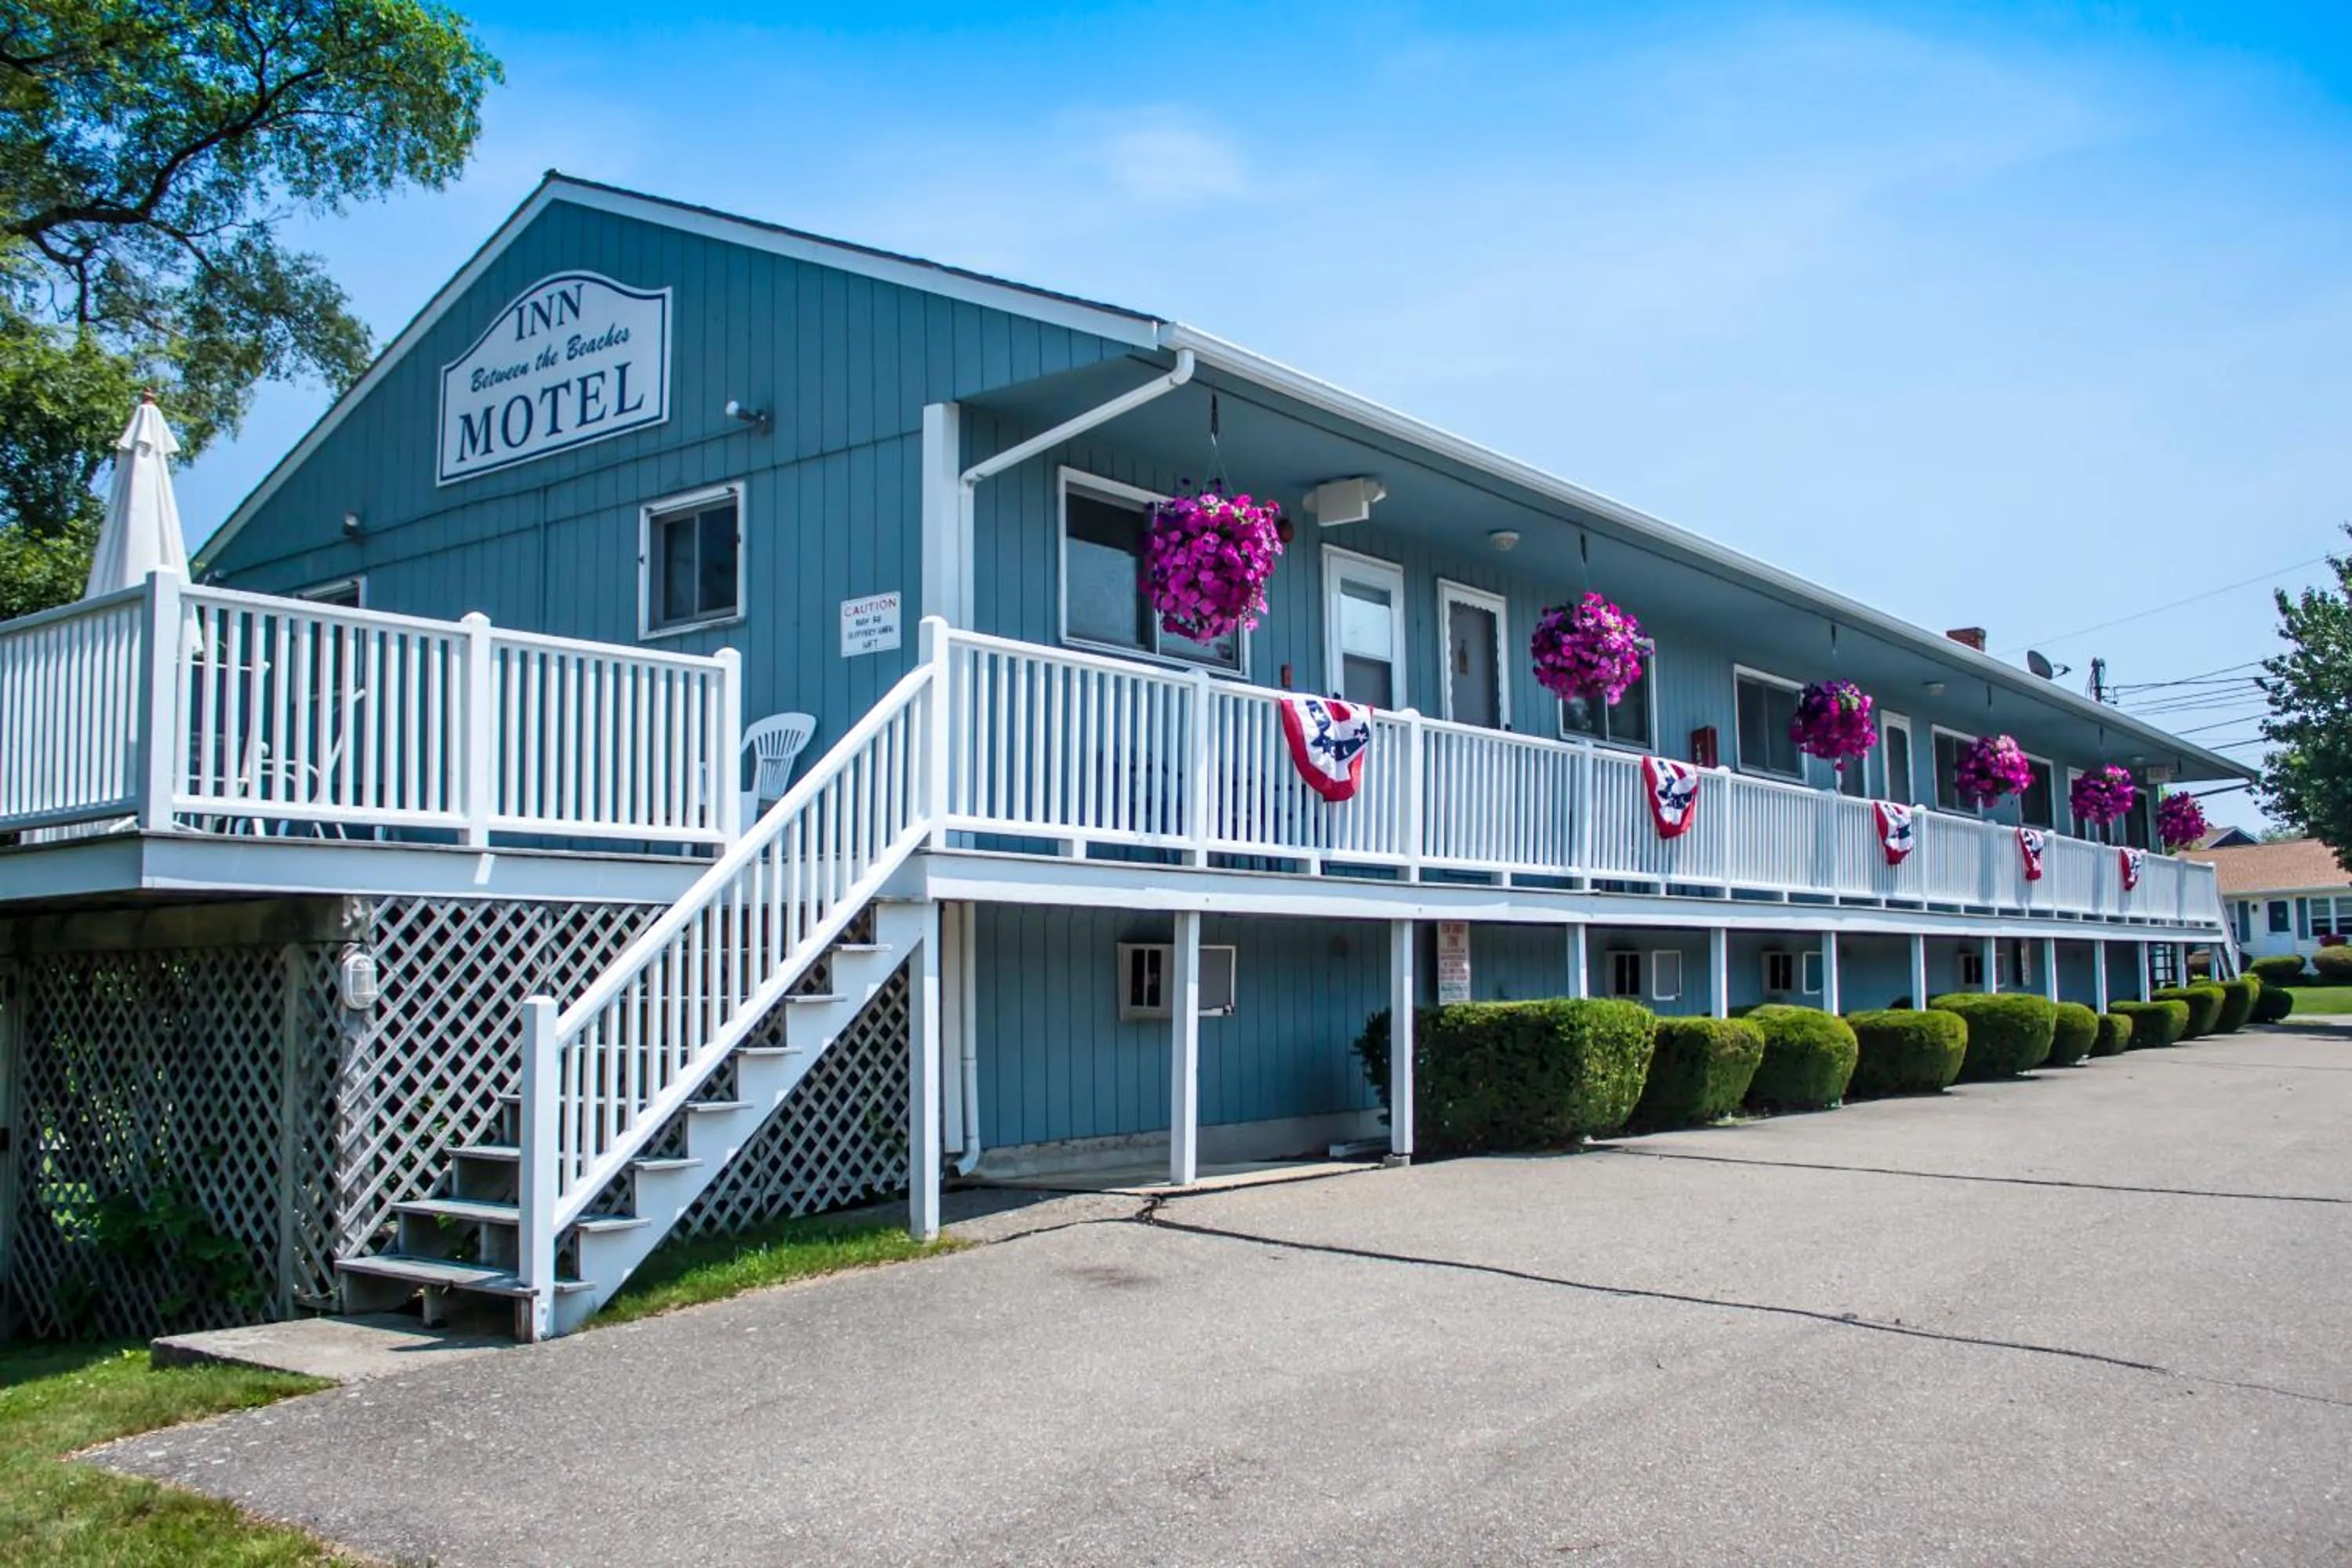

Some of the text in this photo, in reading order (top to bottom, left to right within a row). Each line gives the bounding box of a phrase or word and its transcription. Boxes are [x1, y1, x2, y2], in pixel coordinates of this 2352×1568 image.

[514, 283, 585, 341] INN
[470, 322, 631, 393] Between the Beaches
[456, 361, 644, 463] MOTEL
[844, 597, 897, 617] CAUTION
